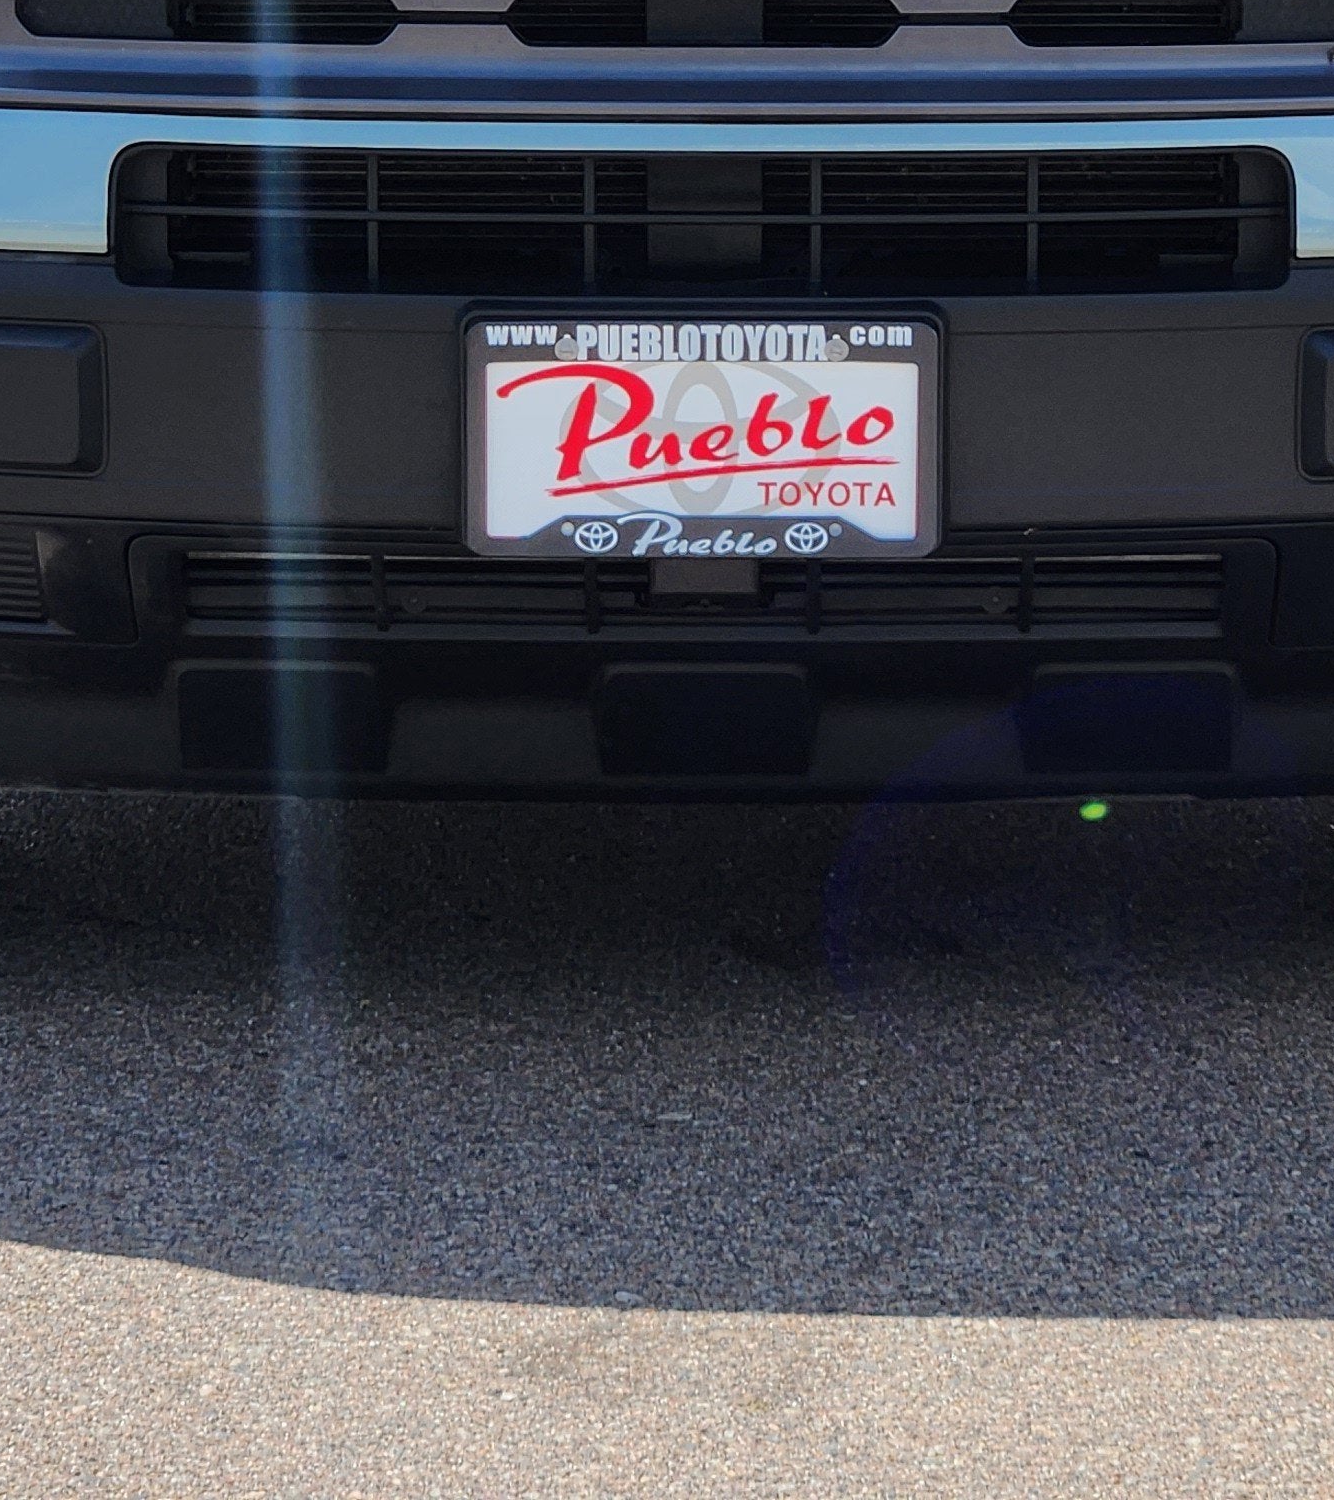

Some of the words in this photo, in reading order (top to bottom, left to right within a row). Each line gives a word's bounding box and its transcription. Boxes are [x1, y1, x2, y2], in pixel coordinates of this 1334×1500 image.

[496, 364, 895, 480] Pueblo
[757, 481, 897, 507] TOYOTA
[617, 511, 778, 557] Pueblo
